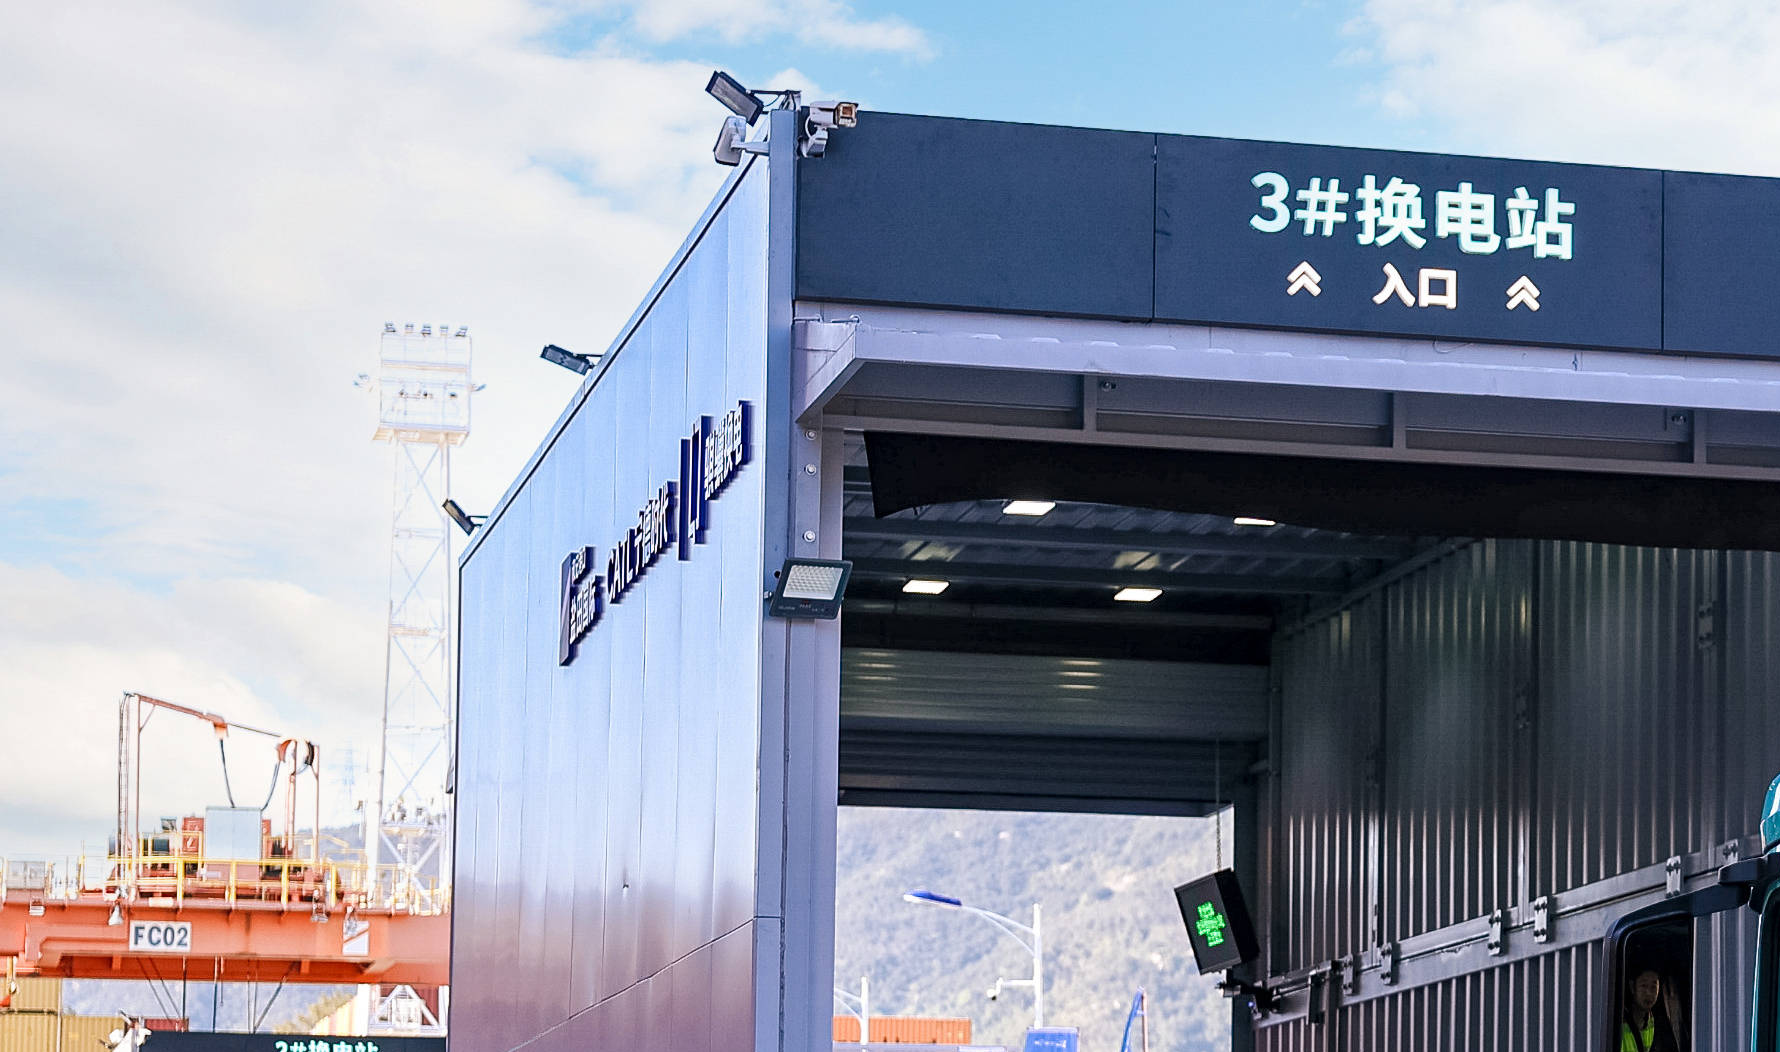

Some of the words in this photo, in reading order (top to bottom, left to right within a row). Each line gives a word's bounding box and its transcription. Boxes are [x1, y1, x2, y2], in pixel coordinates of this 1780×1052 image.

[1248, 171, 1576, 261] 3#换电站
[1372, 262, 1458, 310] 入口
[133, 926, 188, 946] FC02
